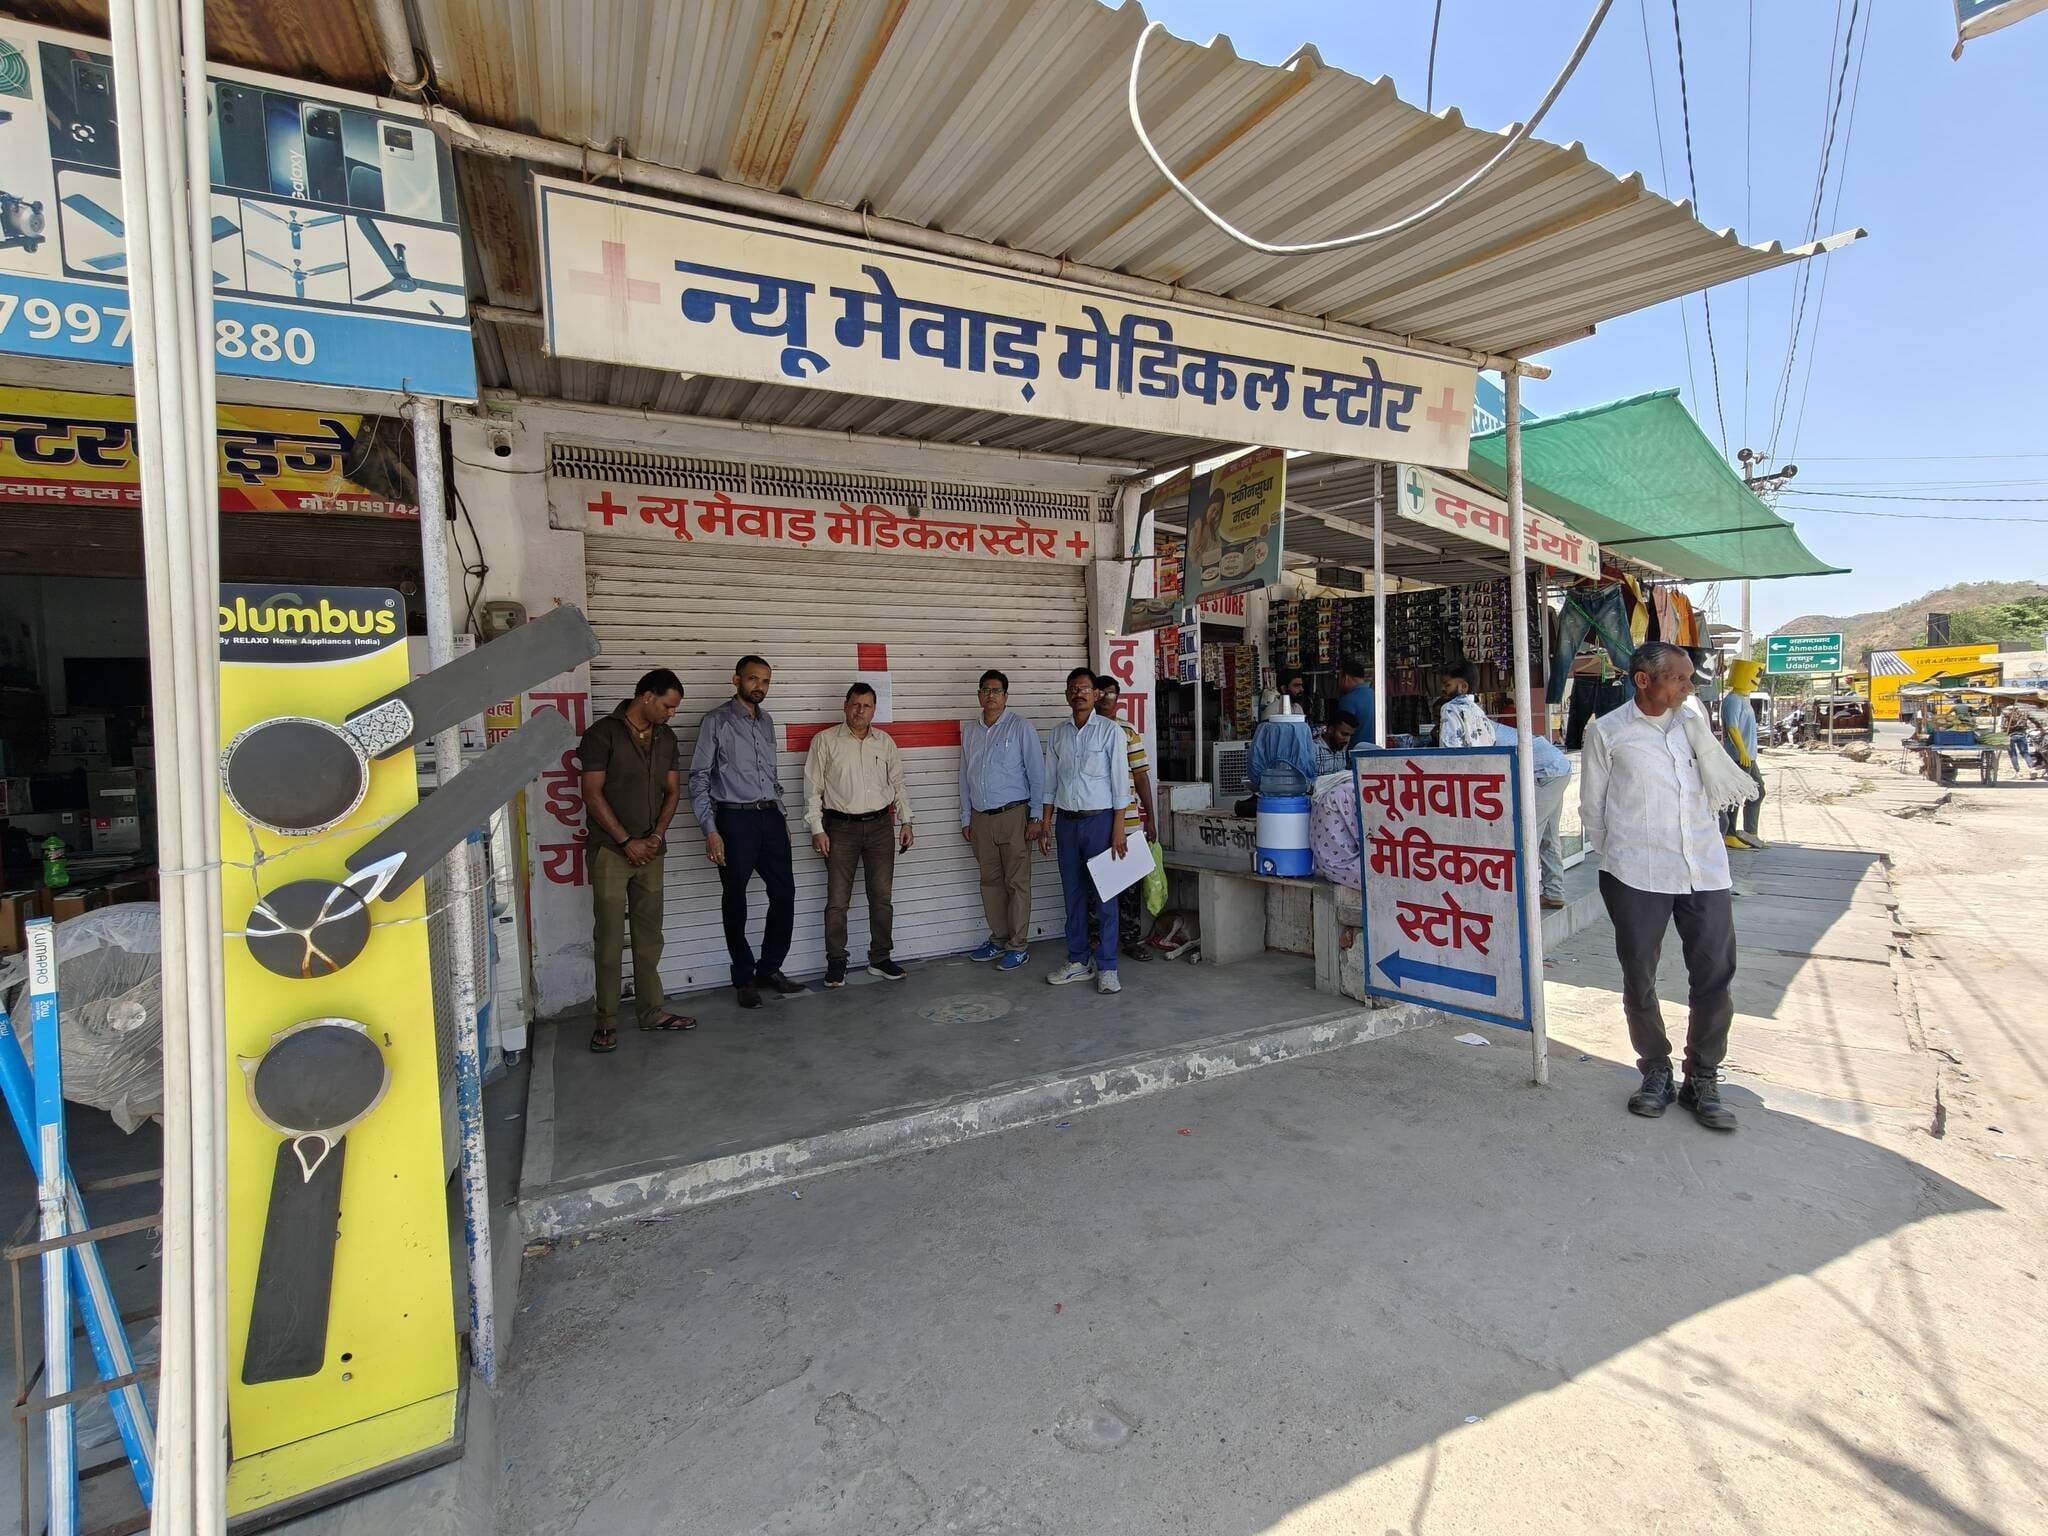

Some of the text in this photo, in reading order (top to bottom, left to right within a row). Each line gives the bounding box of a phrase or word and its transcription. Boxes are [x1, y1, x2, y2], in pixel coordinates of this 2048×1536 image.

[674, 260, 1422, 433] न्यू मेवाड़ मेडिकल स्टोर
[72, 486, 120, 500] बस
[335, 499, 420, 515] 9799742
[637, 491, 1057, 558] न्यू मेवाड़ मेडिकल स्टोर
[219, 597, 396, 634] olumbus
[233, 637, 269, 645] RELAXO
[301, 638, 351, 646] Aappliances
[354, 638, 381, 646] (India)
[1788, 644, 1839, 652] Ahmedabad
[1361, 760, 1505, 827] न्यू मेवाड़
[1199, 819, 1256, 850] फोटो-कॉप
[1370, 825, 1516, 892] मेडिकल
[1396, 891, 1493, 955] स्टोर
[34, 932, 49, 985] LUMAPRO
